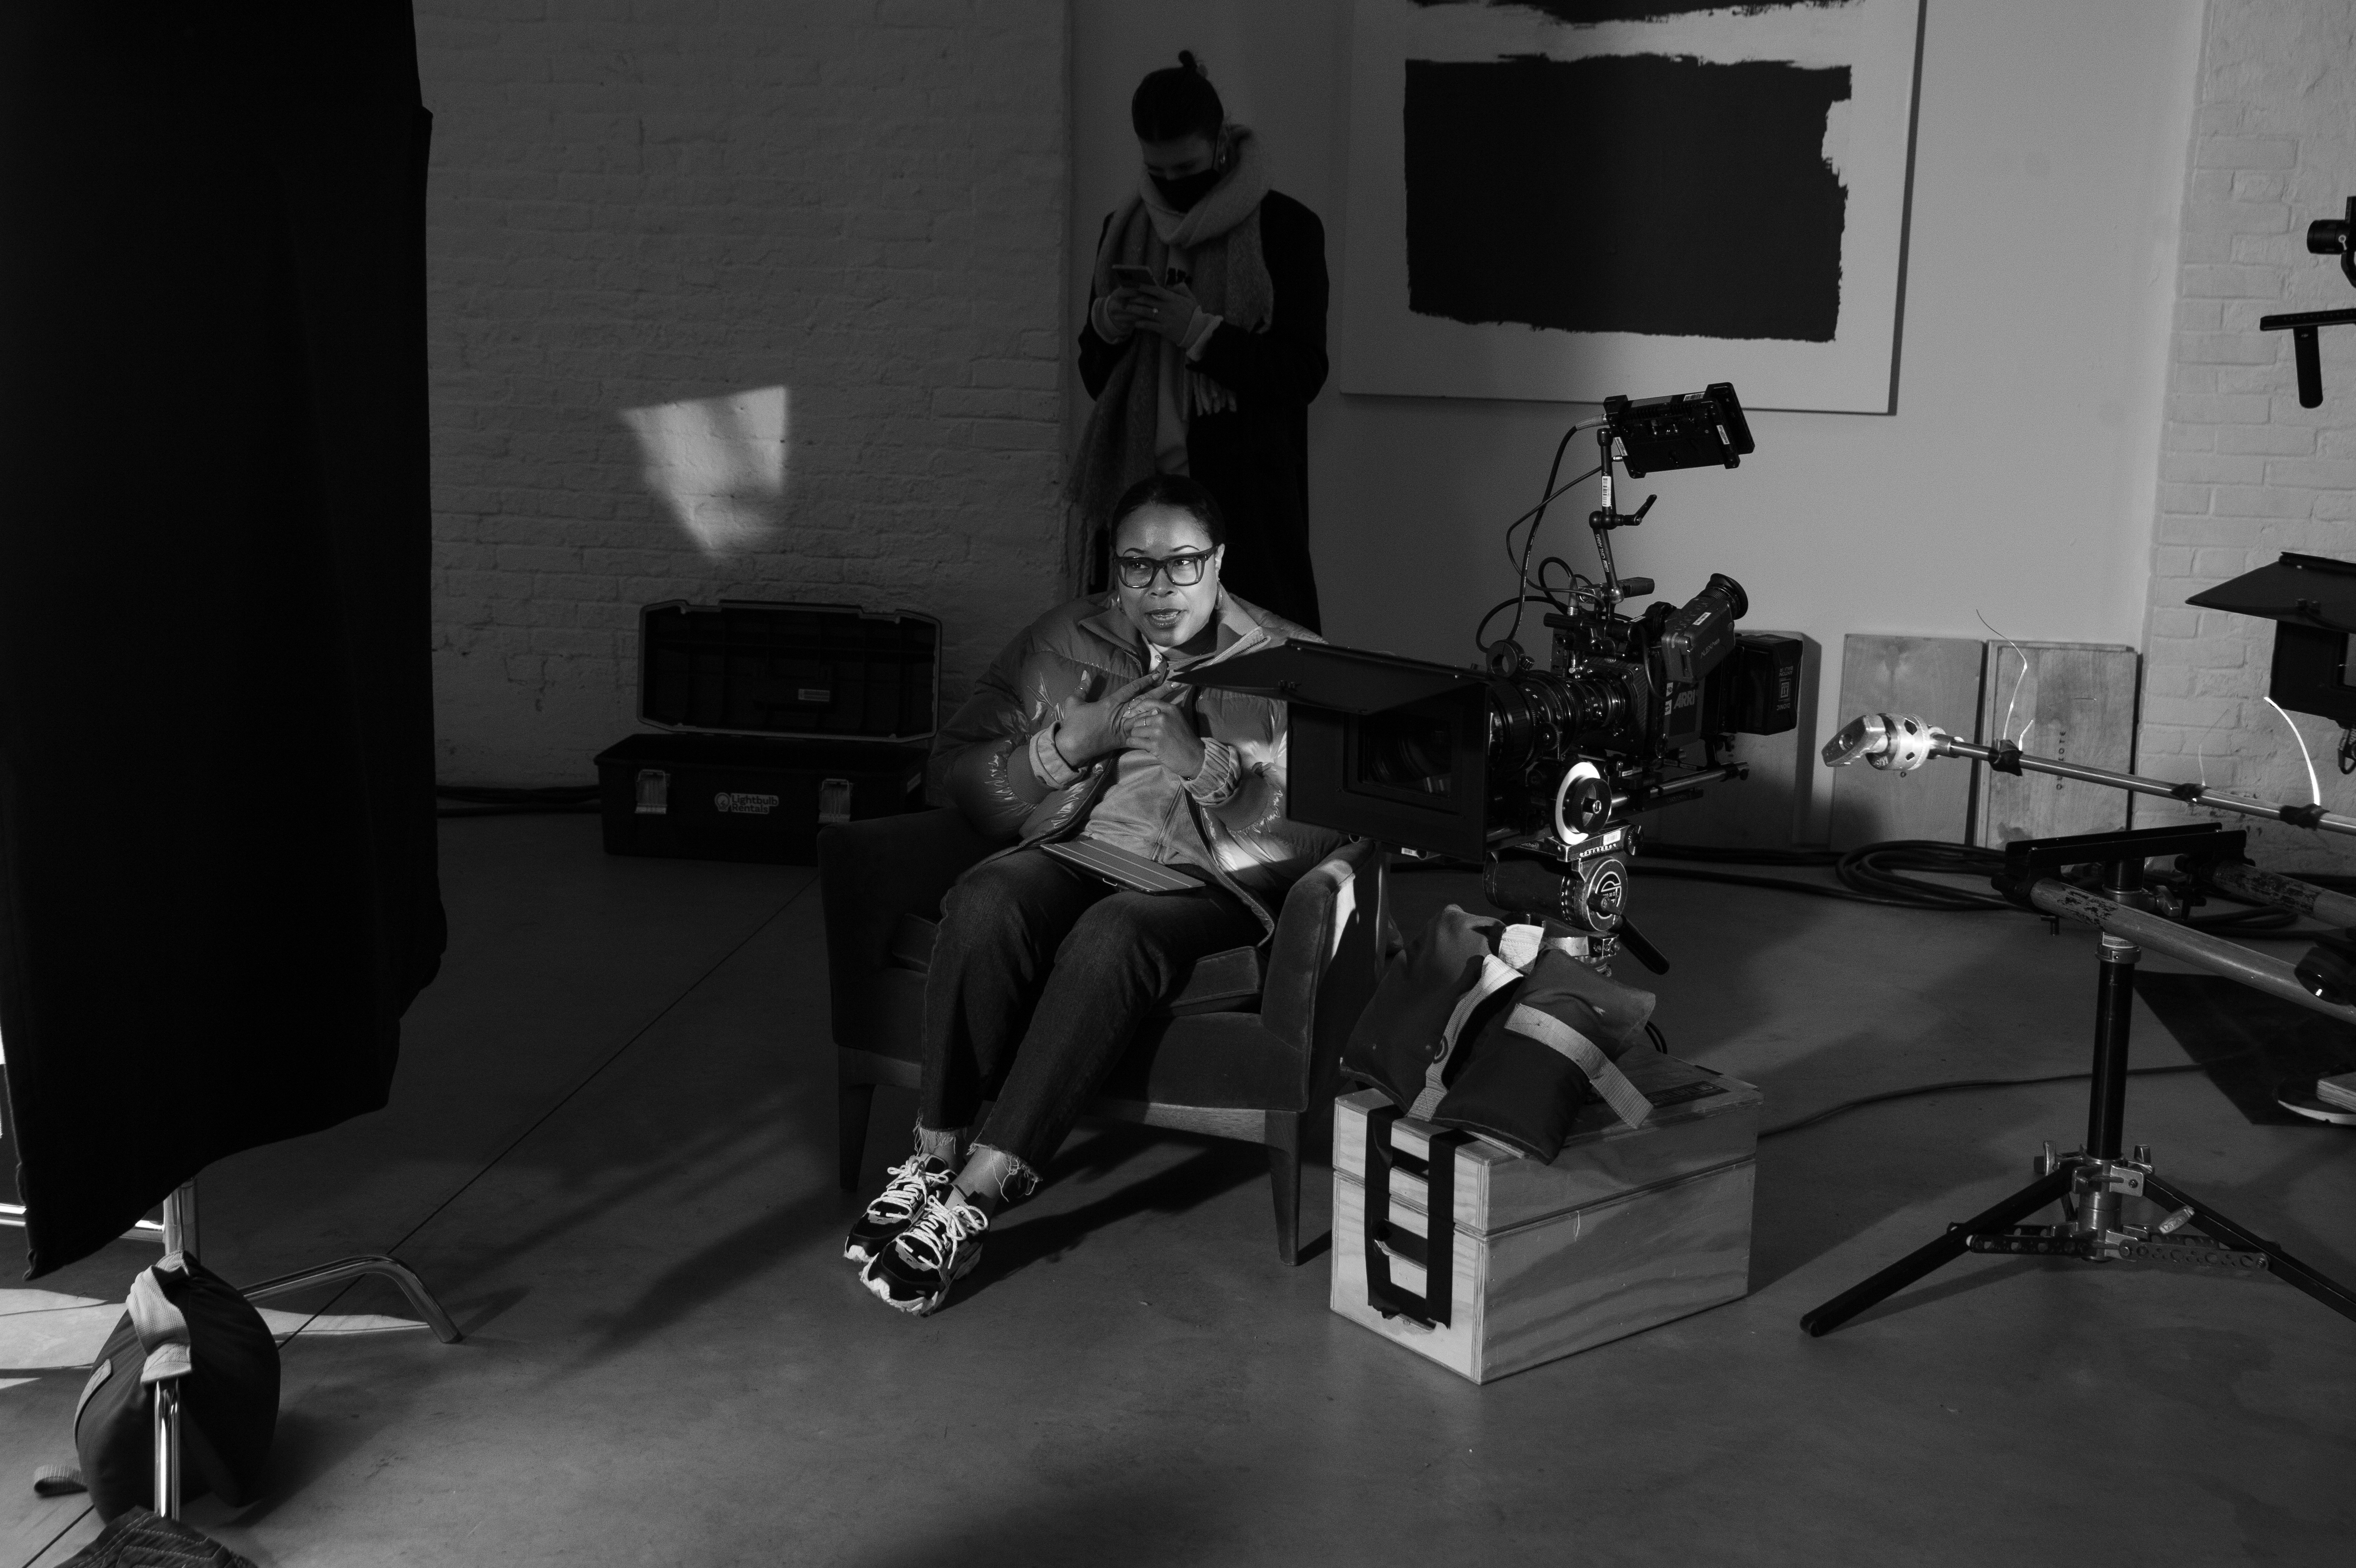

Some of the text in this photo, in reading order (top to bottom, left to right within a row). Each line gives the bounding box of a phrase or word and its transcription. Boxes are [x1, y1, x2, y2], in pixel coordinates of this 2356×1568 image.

[1673, 689, 1695, 710] ARRI
[1777, 702, 1790, 711] DIONIC
[732, 795, 778, 806] Lightbulb
[732, 804, 768, 813] Rentals
